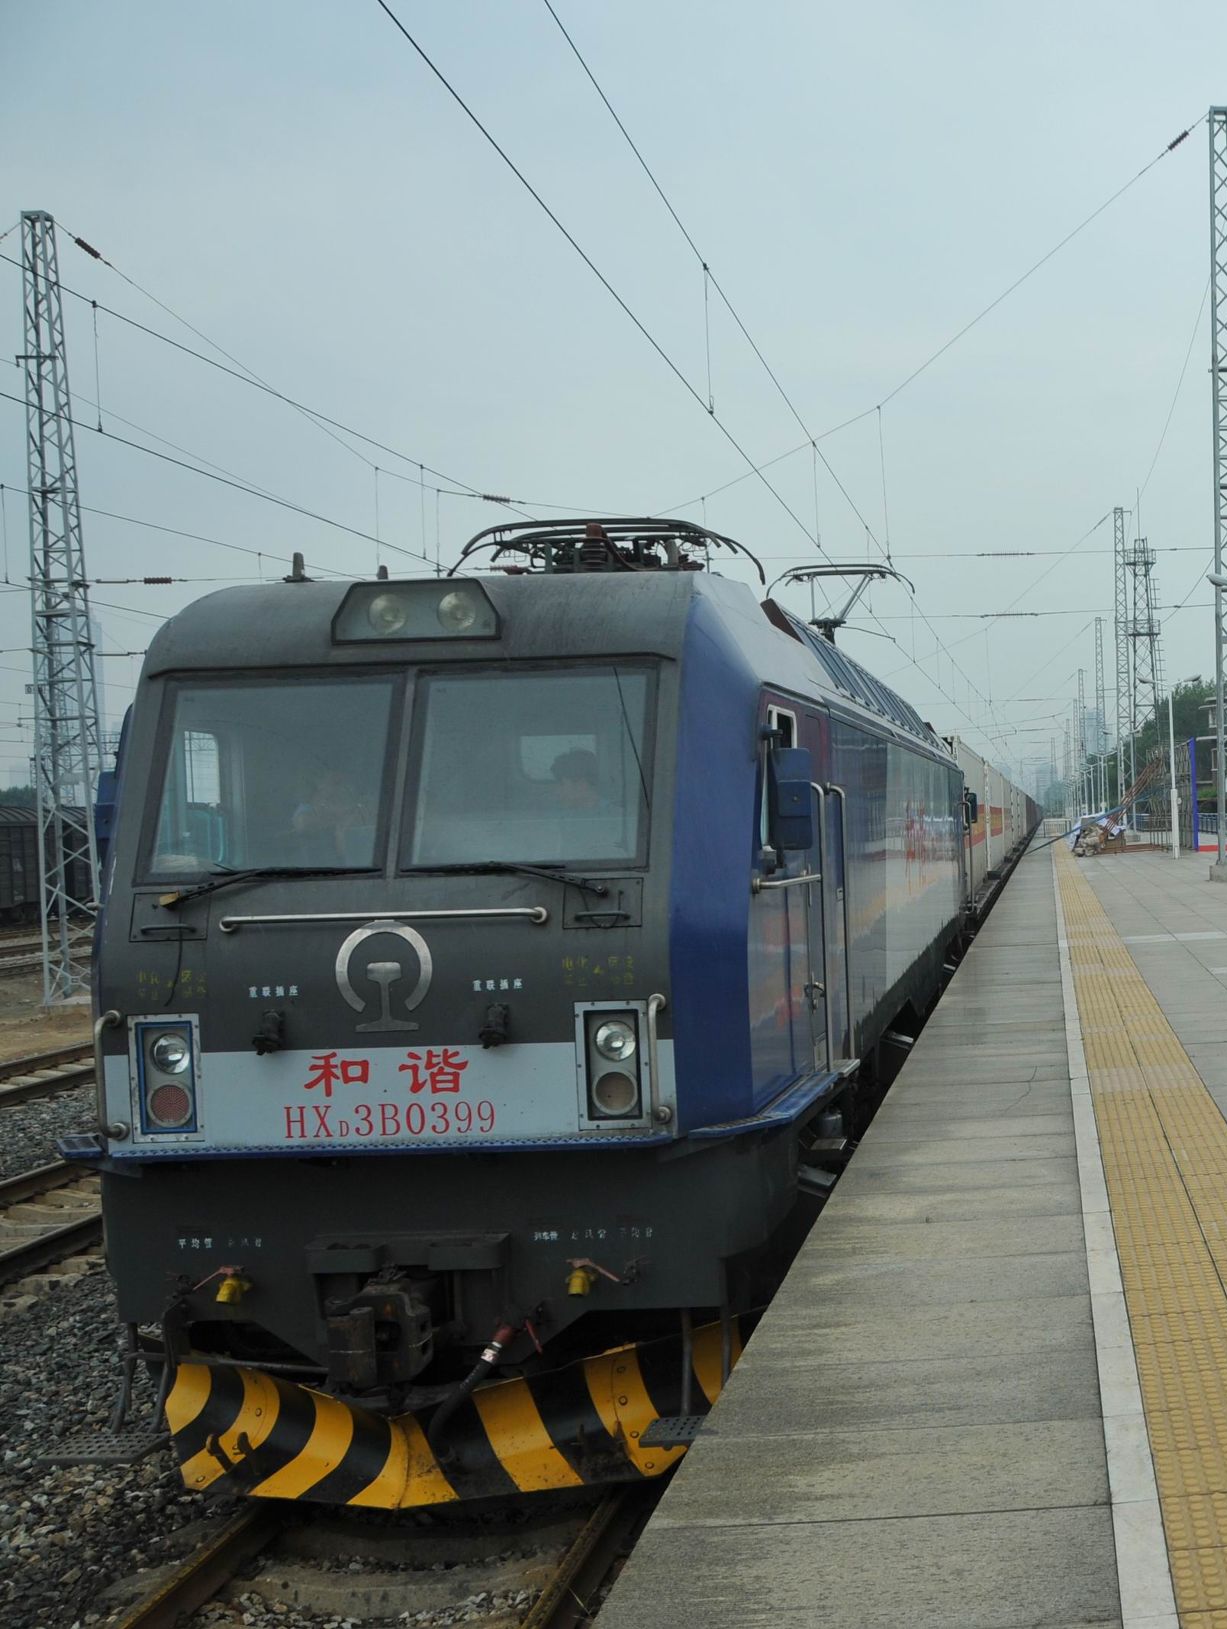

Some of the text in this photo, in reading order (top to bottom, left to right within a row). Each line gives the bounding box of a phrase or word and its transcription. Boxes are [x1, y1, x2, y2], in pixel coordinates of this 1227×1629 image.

[248, 985, 299, 998] 重联插座
[472, 978, 523, 991] 重联插座
[304, 1048, 469, 1097] 和谐
[285, 1101, 496, 1139] HXD3B0399
